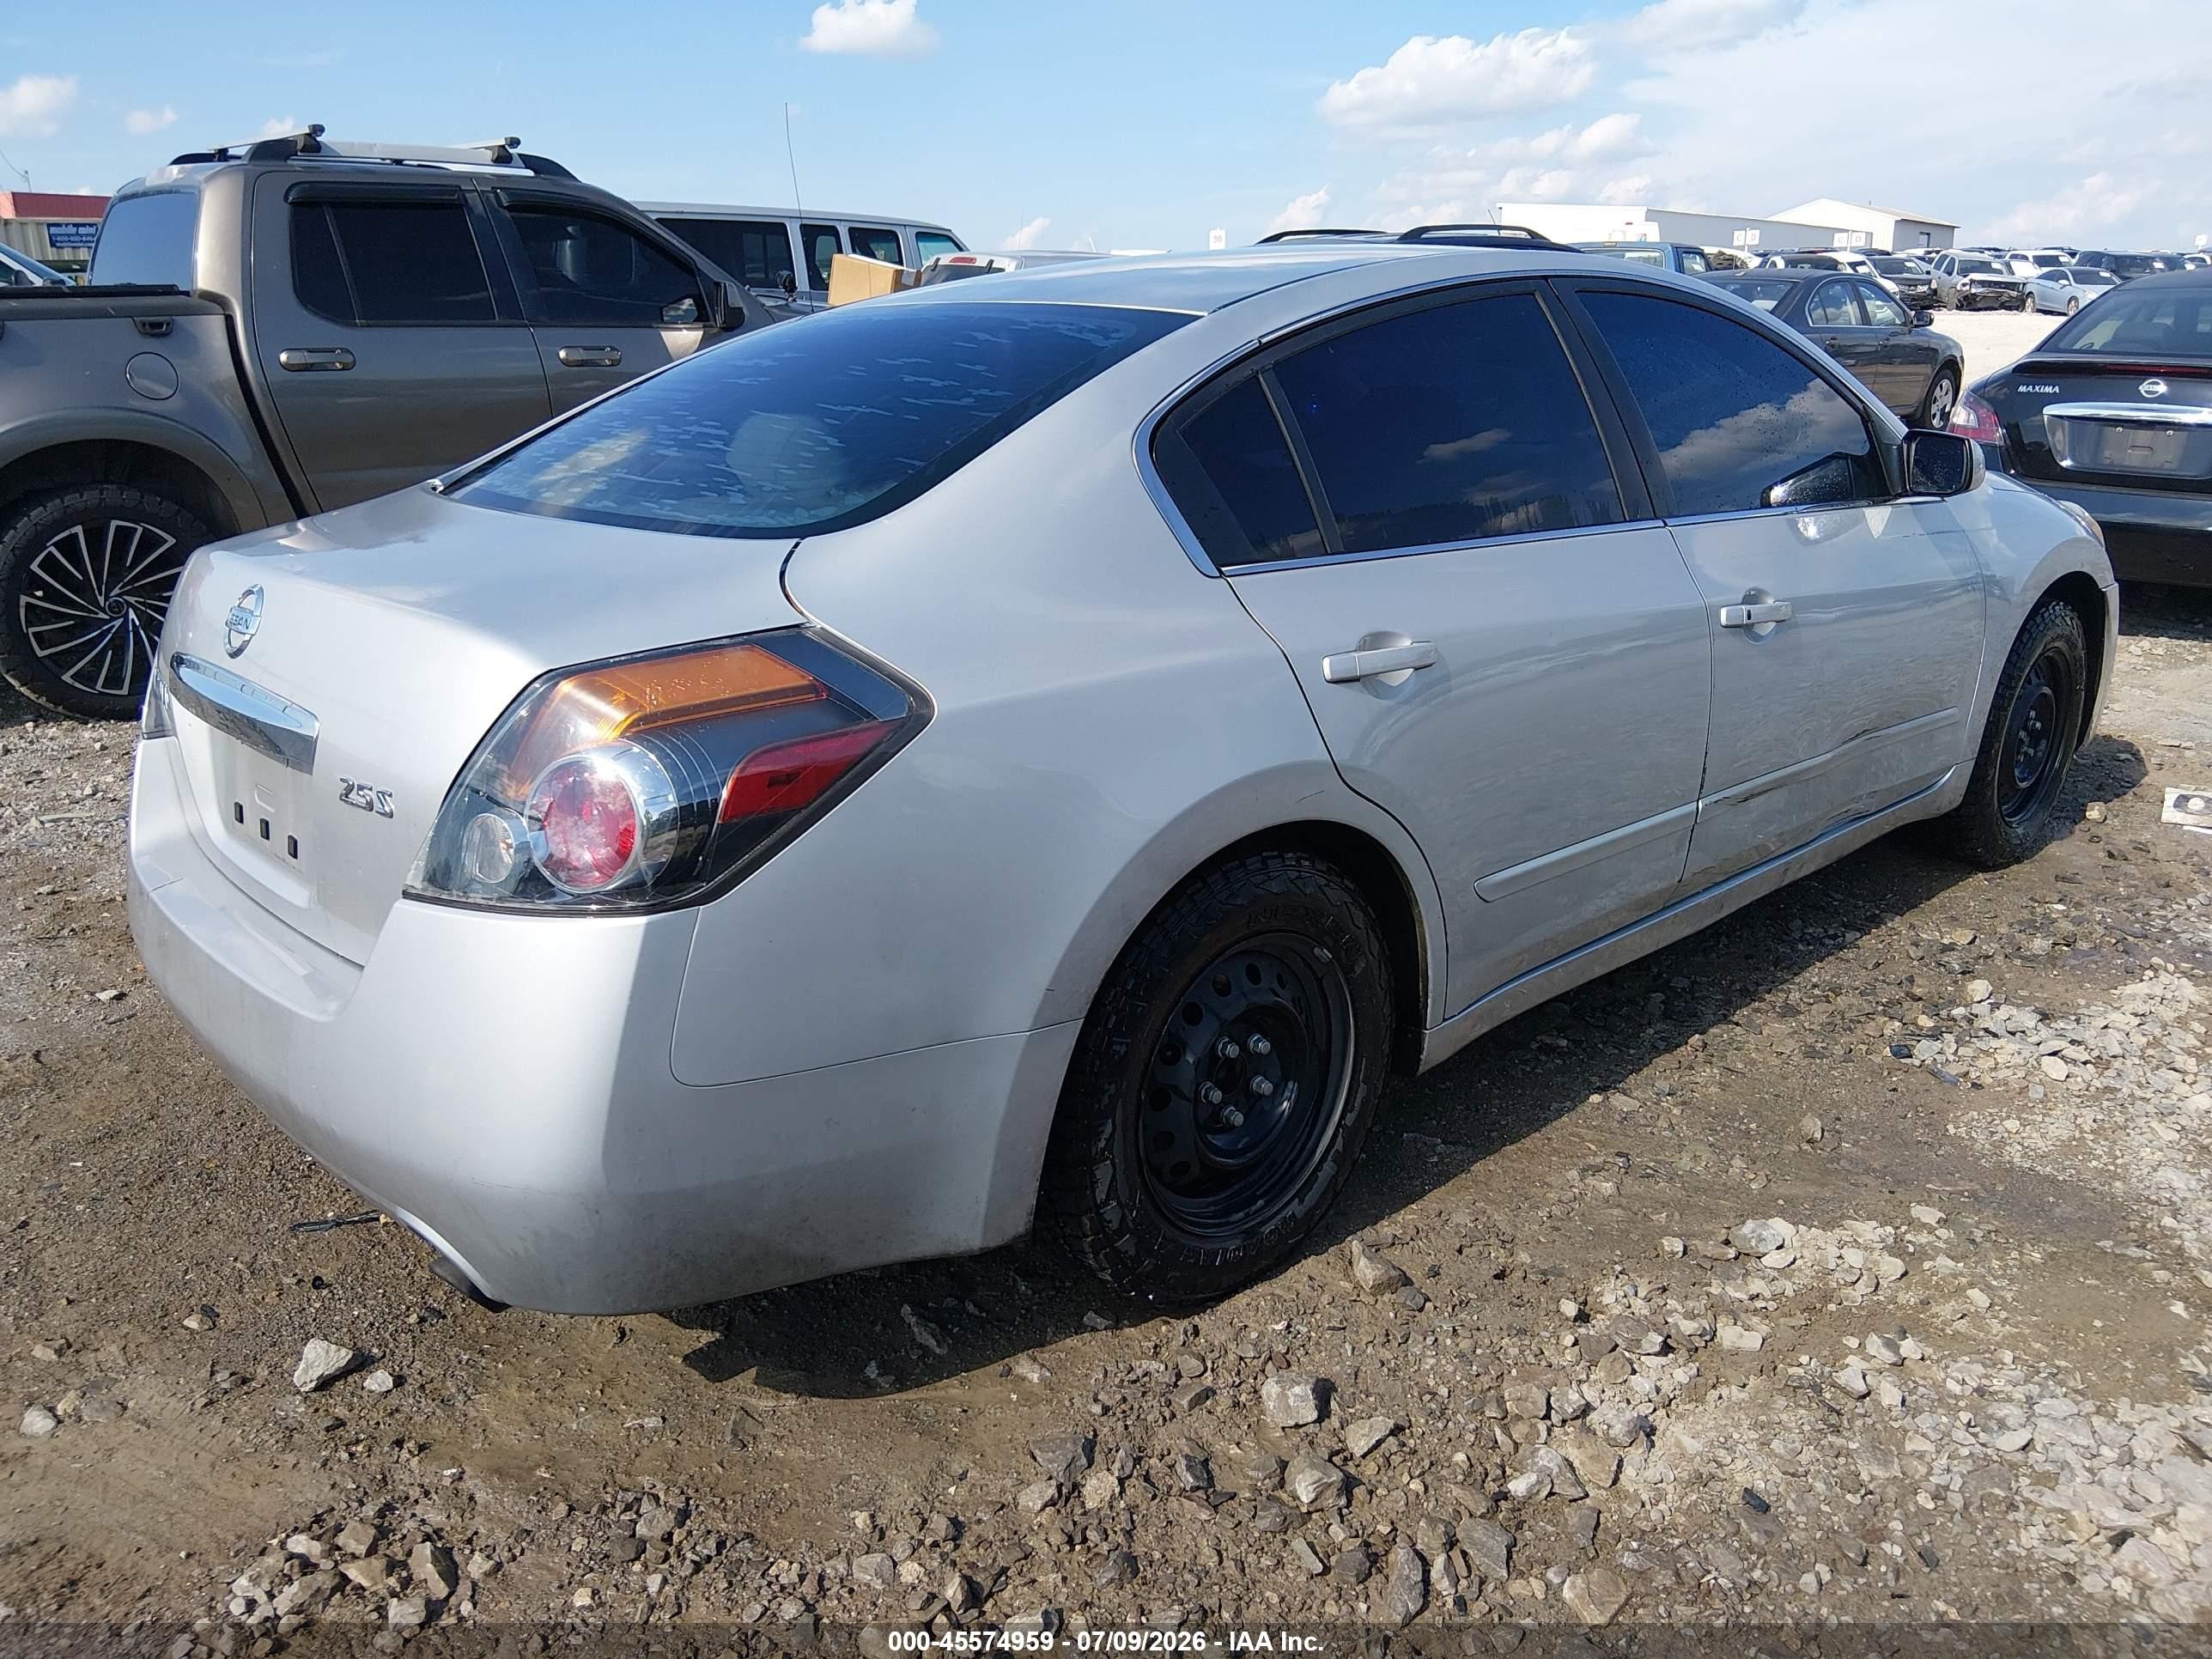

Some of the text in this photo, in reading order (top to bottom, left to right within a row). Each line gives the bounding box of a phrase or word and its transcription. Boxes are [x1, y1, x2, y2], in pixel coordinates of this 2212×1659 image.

[50, 224, 97, 234] mobile mini
[2018, 385, 2059, 393] MAXIMA
